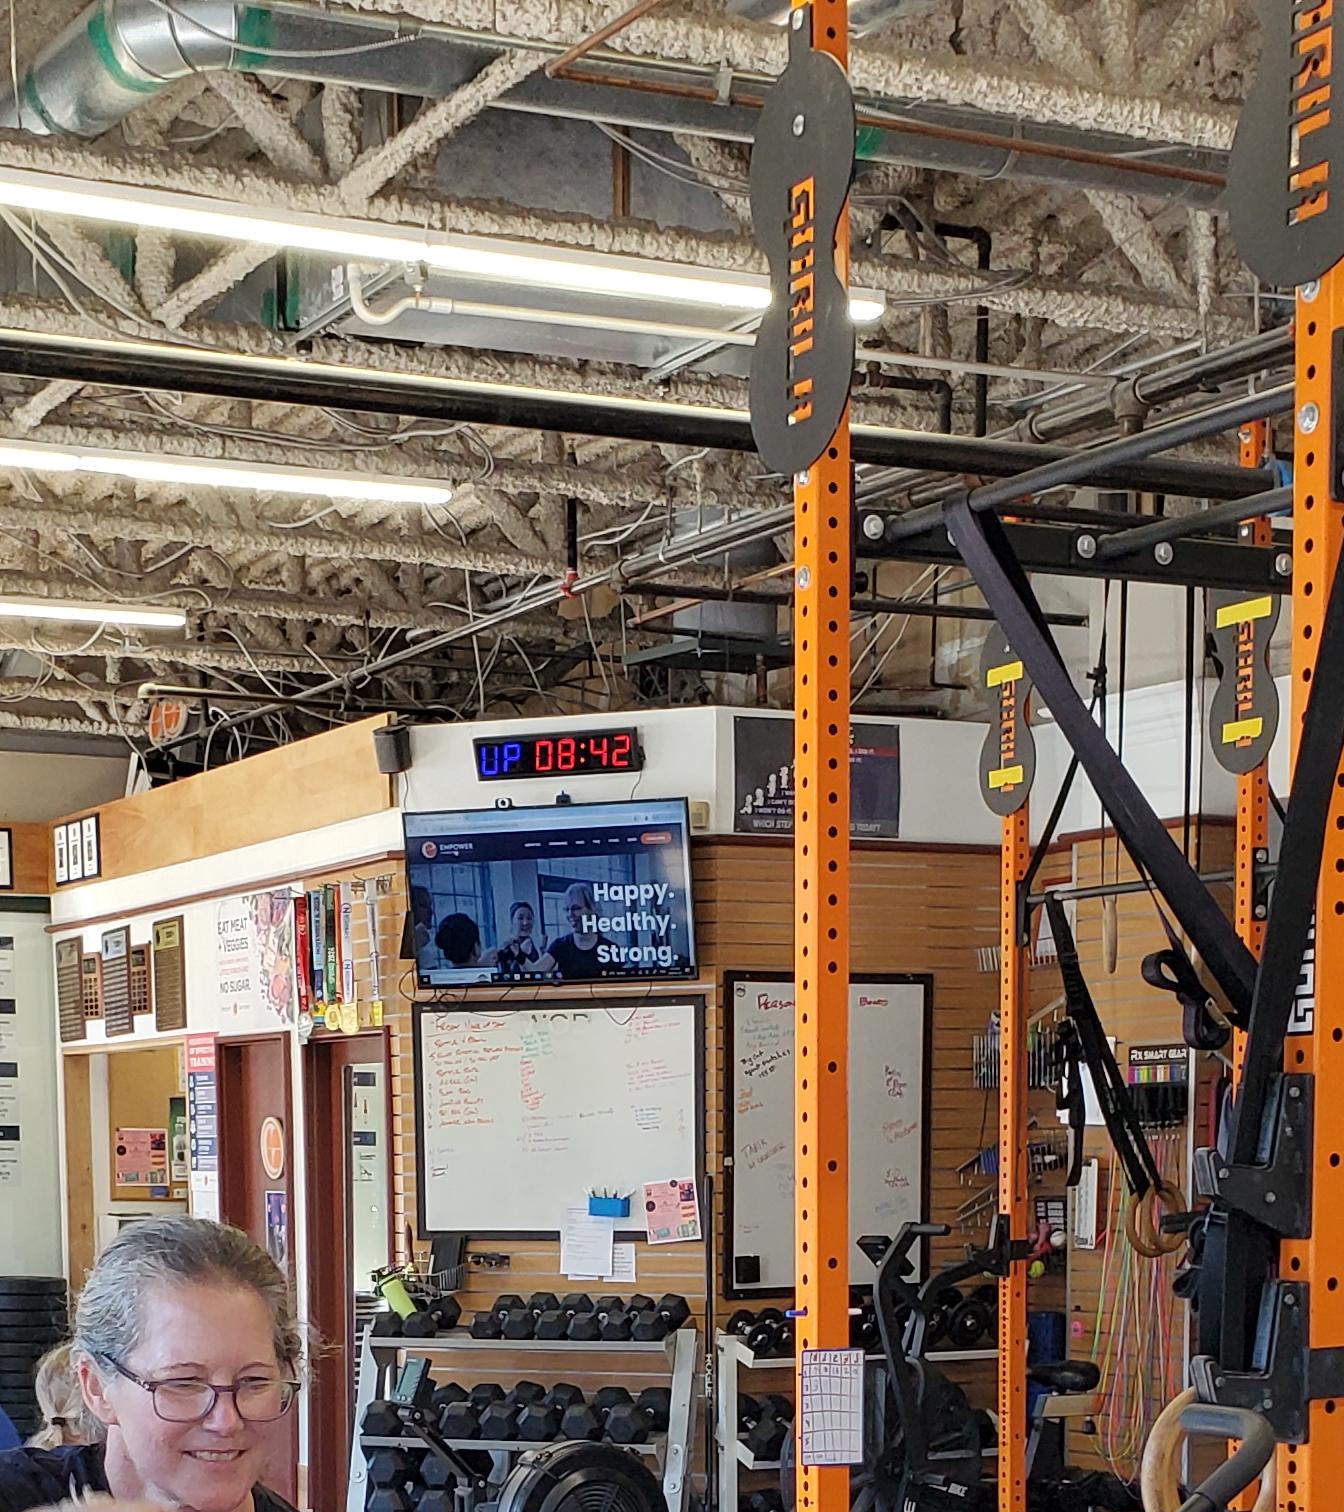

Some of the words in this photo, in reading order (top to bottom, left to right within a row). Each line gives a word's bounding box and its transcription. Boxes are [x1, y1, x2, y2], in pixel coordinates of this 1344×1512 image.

[481, 743, 521, 776] UP
[535, 735, 630, 771] 08:42
[752, 819, 775, 829] WHICH
[439, 842, 474, 851] EMPOWER
[593, 882, 676, 907] Happy.
[218, 920, 230, 936] EAT
[230, 917, 248, 932] MEAT
[581, 913, 678, 937] Healthy.
[223, 937, 249, 953] VEGGIES
[596, 945, 679, 967] Strong.
[220, 981, 229, 994] NO
[1144, 1049, 1167, 1060] SMART
[1168, 1048, 1187, 1059] GEAR
[948, 1482, 968, 1498] BIKE
